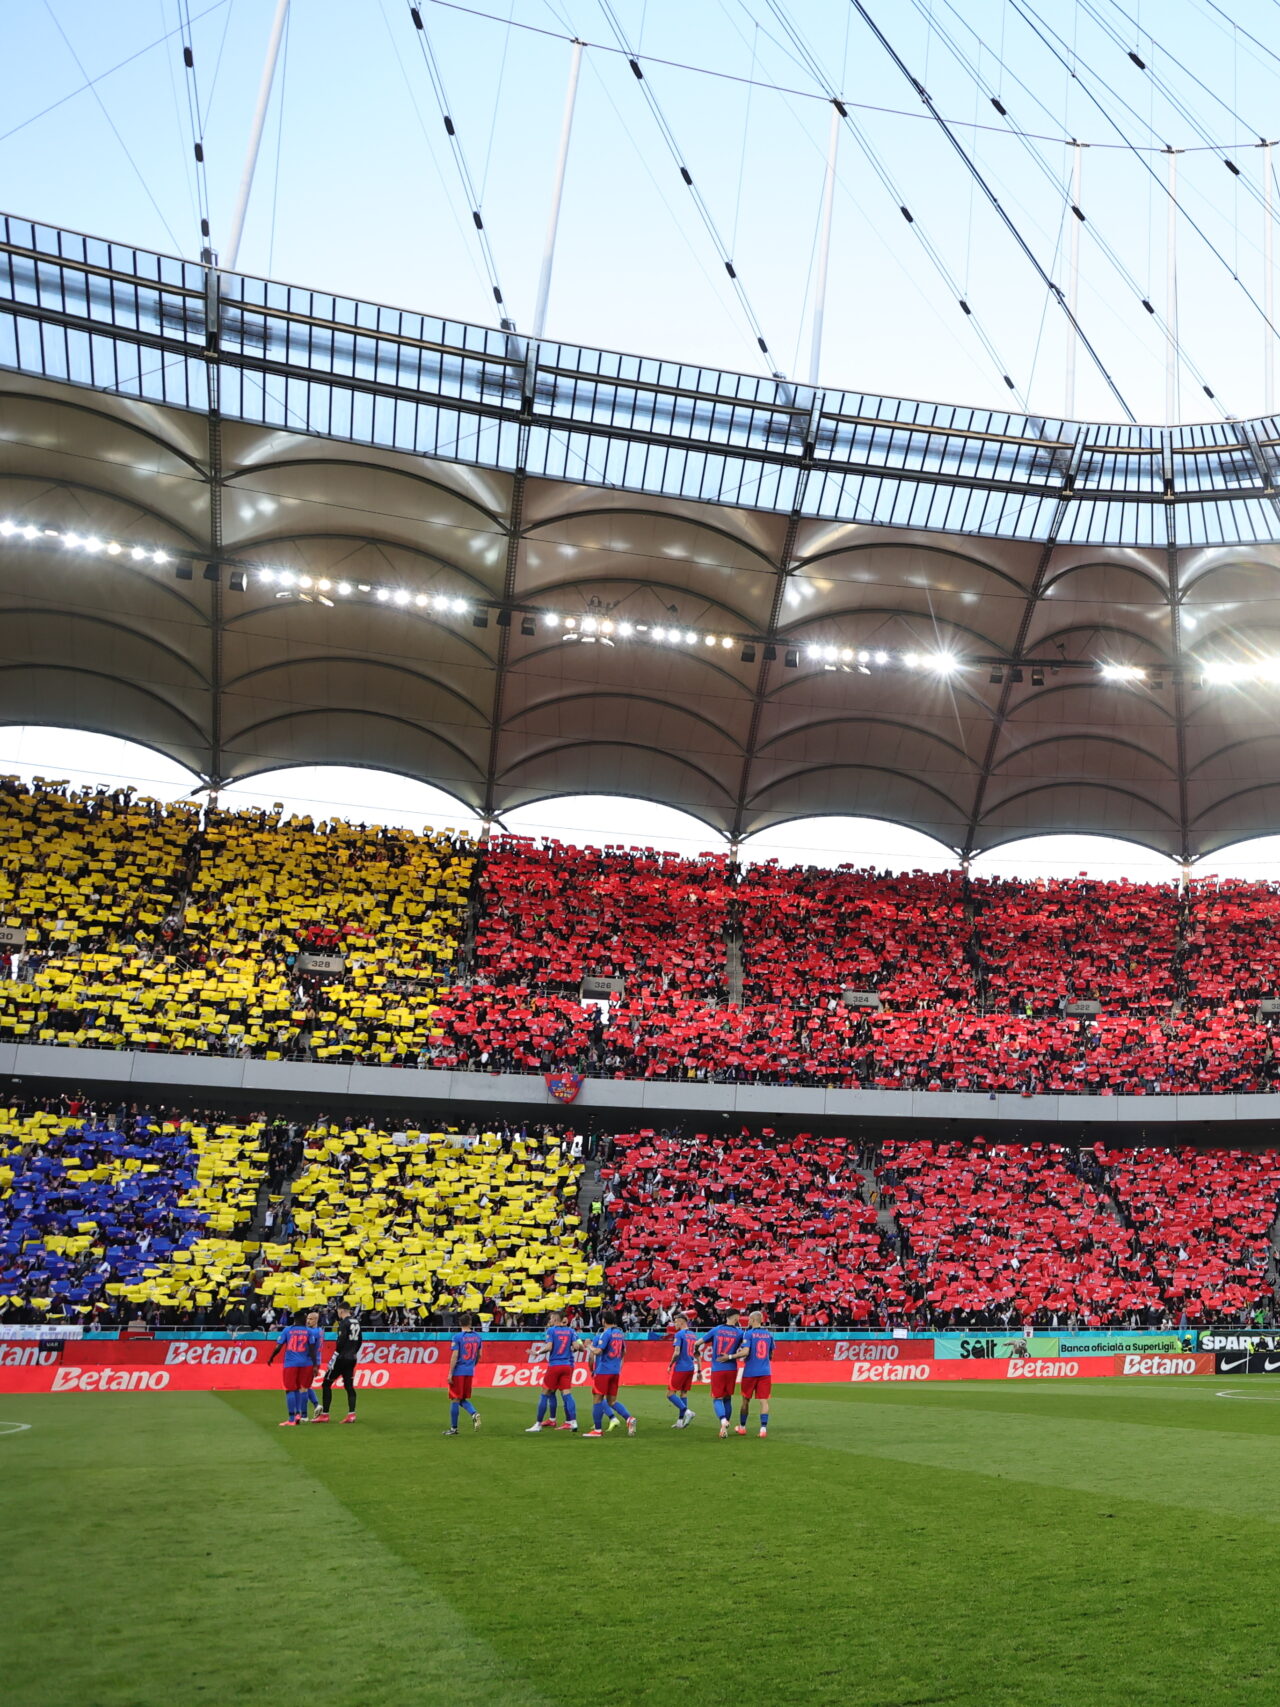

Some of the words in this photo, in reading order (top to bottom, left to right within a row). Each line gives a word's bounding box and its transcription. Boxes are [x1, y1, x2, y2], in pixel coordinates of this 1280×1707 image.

[312, 960, 331, 968] 328
[349, 1324, 361, 1341] 32
[288, 1335, 308, 1352] 42
[556, 1336, 568, 1354] 7
[717, 1336, 736, 1354] 17
[756, 1340, 767, 1359] 9
[834, 1342, 899, 1361] Betano
[1061, 1344, 1090, 1352] Banca
[1125, 1344, 1131, 1352] a
[165, 1342, 257, 1365] Betano
[356, 1343, 439, 1364] Betano
[852, 1362, 930, 1382] Betano
[1007, 1359, 1079, 1378] Betano
[1123, 1354, 1196, 1375] Betano
[51, 1367, 170, 1391] Betano
